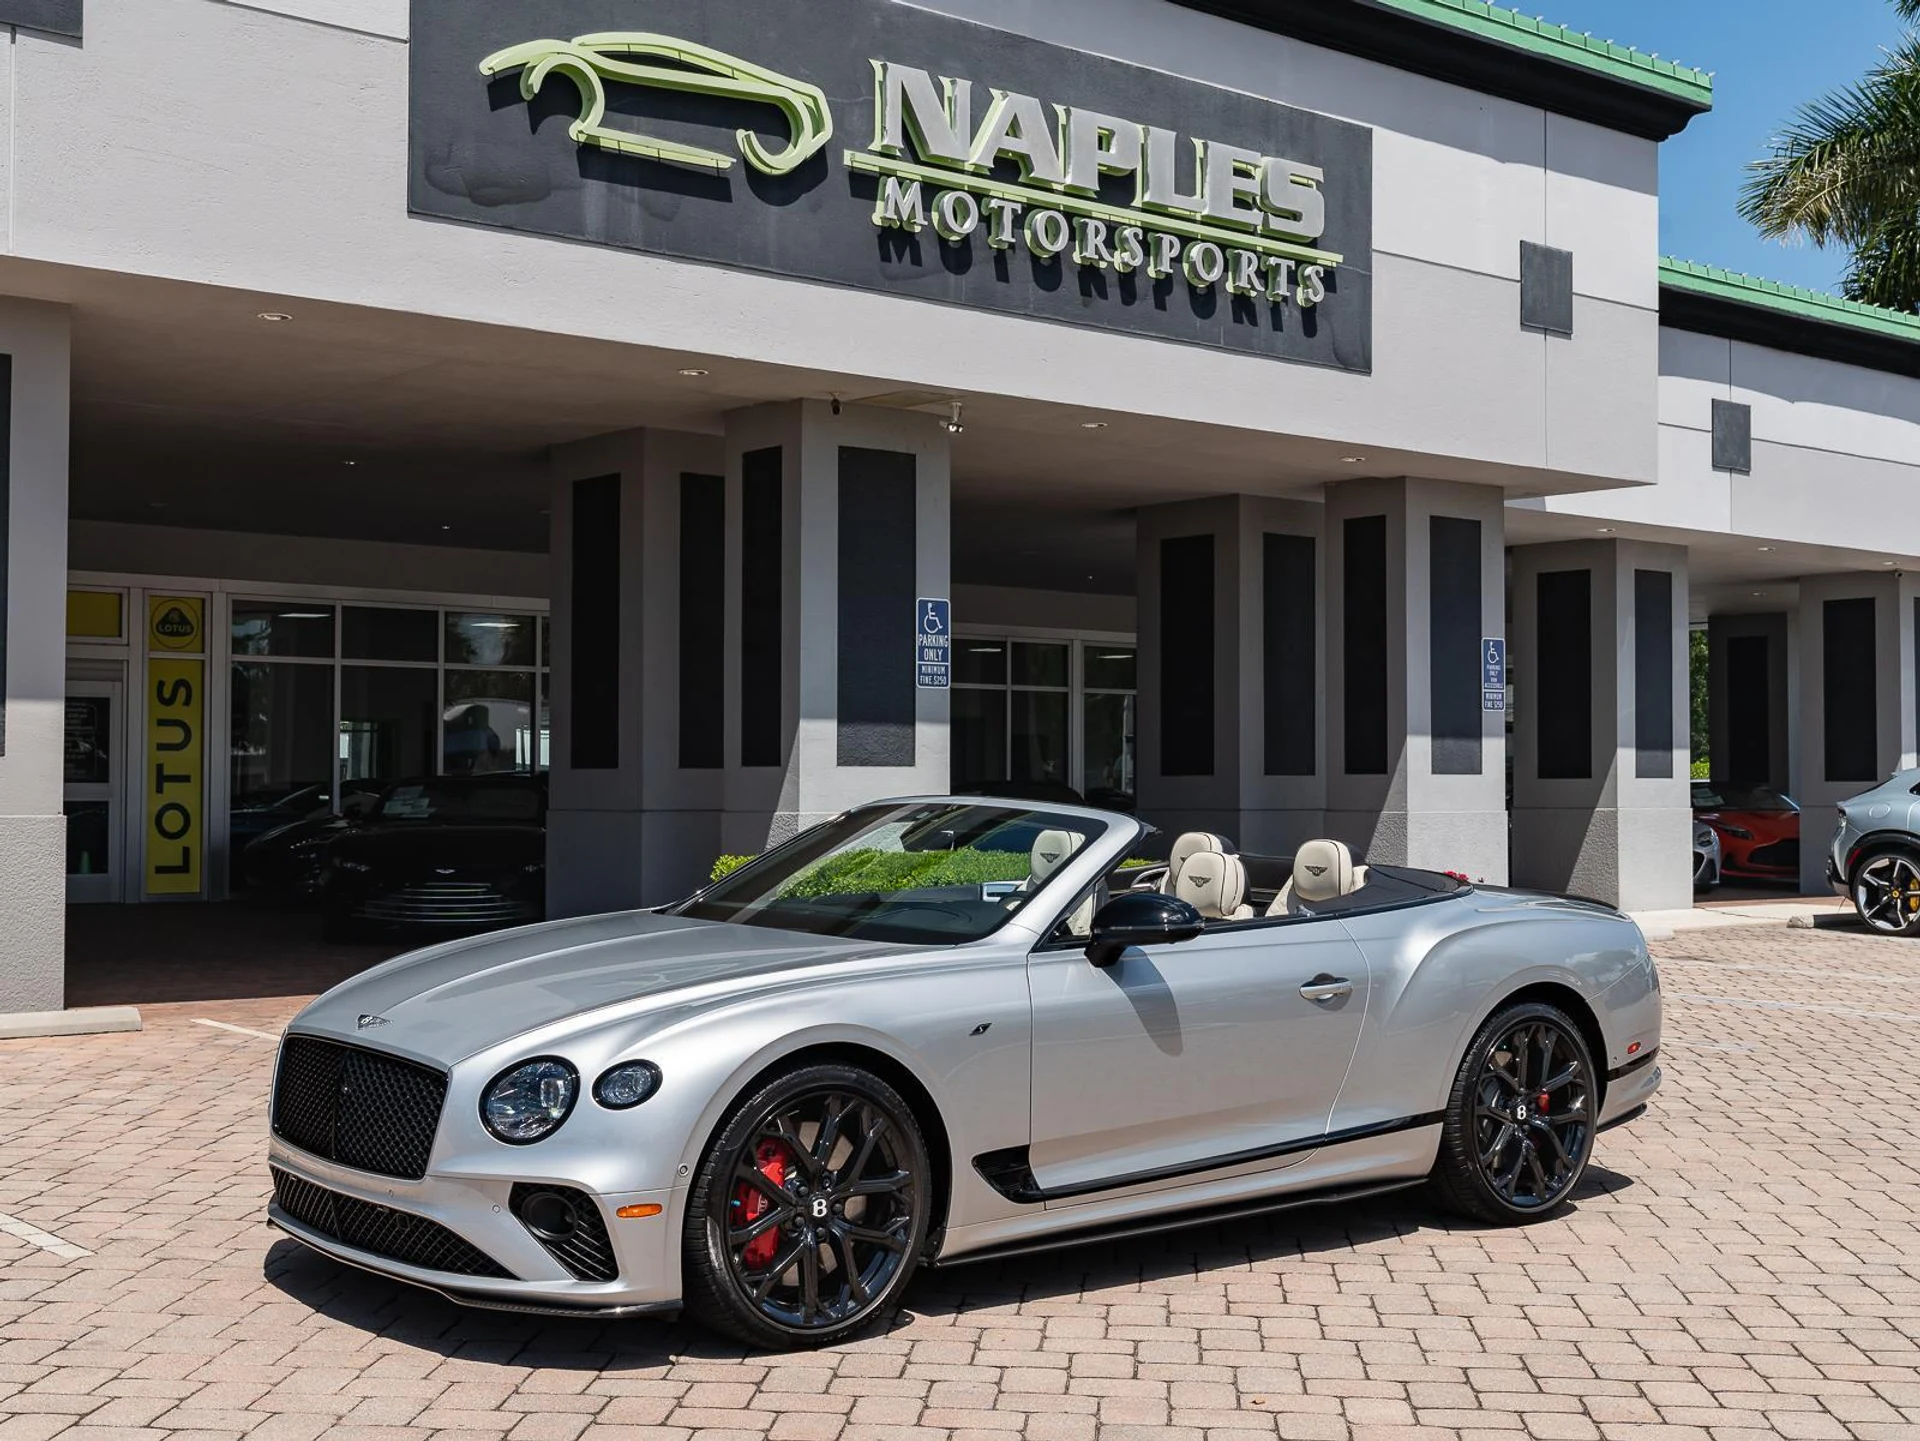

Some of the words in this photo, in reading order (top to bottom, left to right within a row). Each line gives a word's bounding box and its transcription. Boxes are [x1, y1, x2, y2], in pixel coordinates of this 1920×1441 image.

[868, 58, 1325, 240] NAPLES
[873, 176, 1325, 305] MOTORSPORTS
[158, 624, 192, 633] LOTUS
[918, 634, 948, 647] PARKING
[924, 648, 943, 661] ONLY
[154, 677, 193, 874] LOTUS
[1517, 1105, 1526, 1120] B
[812, 1198, 828, 1217] B
